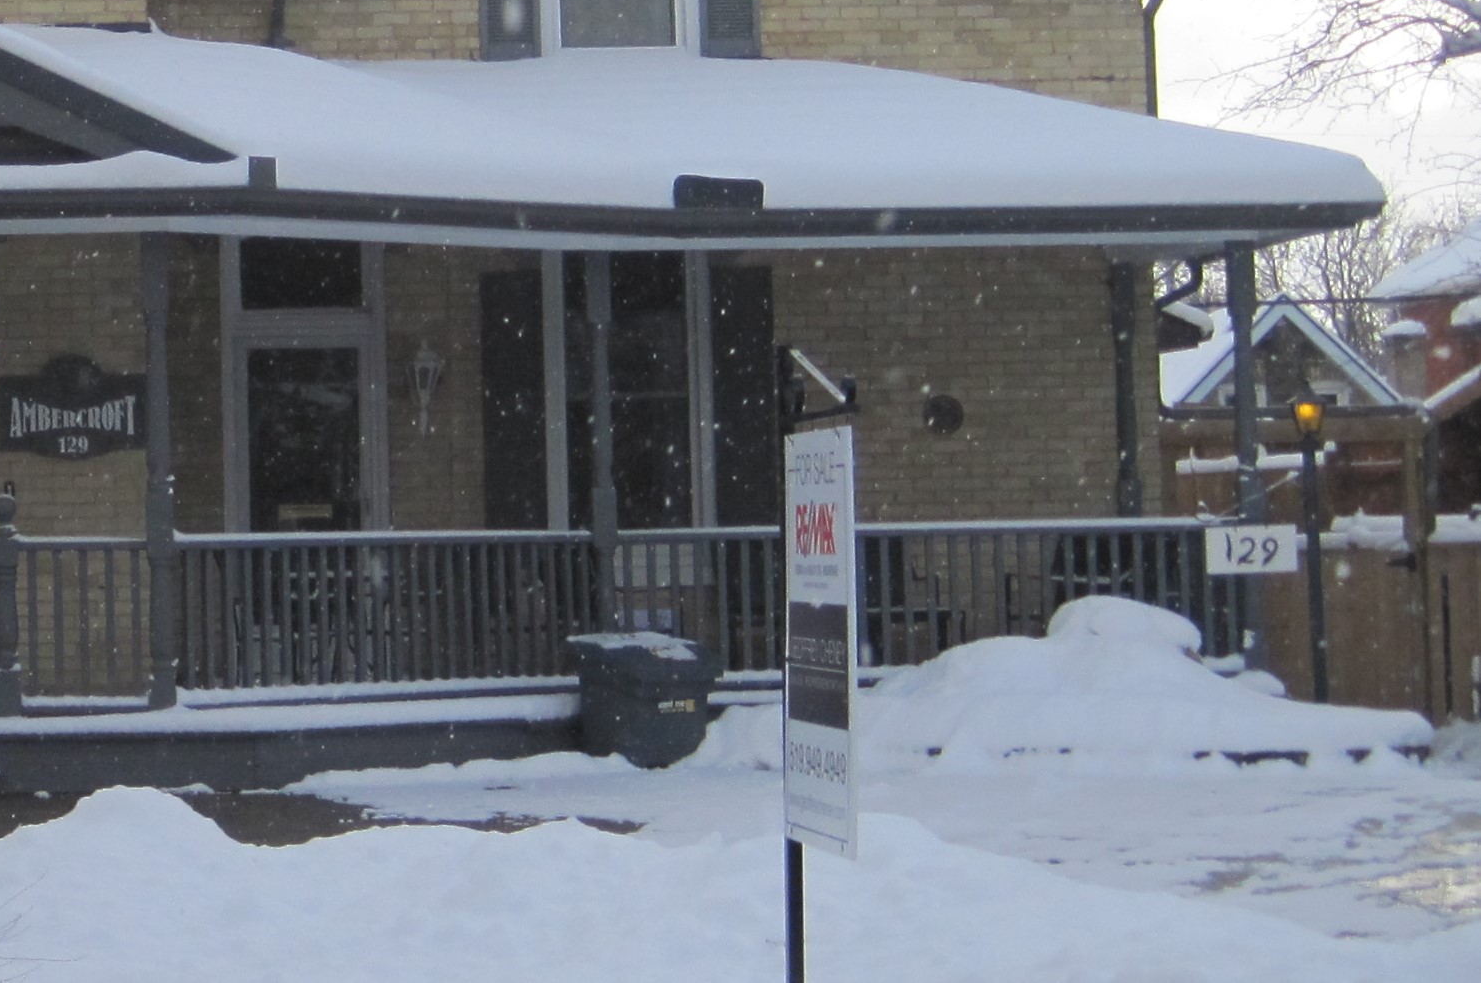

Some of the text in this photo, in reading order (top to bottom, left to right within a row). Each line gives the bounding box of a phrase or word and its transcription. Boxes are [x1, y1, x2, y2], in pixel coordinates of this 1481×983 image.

[10, 395, 136, 438] AMBERCROFT
[58, 436, 89, 454] 129
[795, 451, 835, 486] FOR SALE
[796, 501, 836, 557] RE/MAX
[1224, 532, 1279, 567] 129
